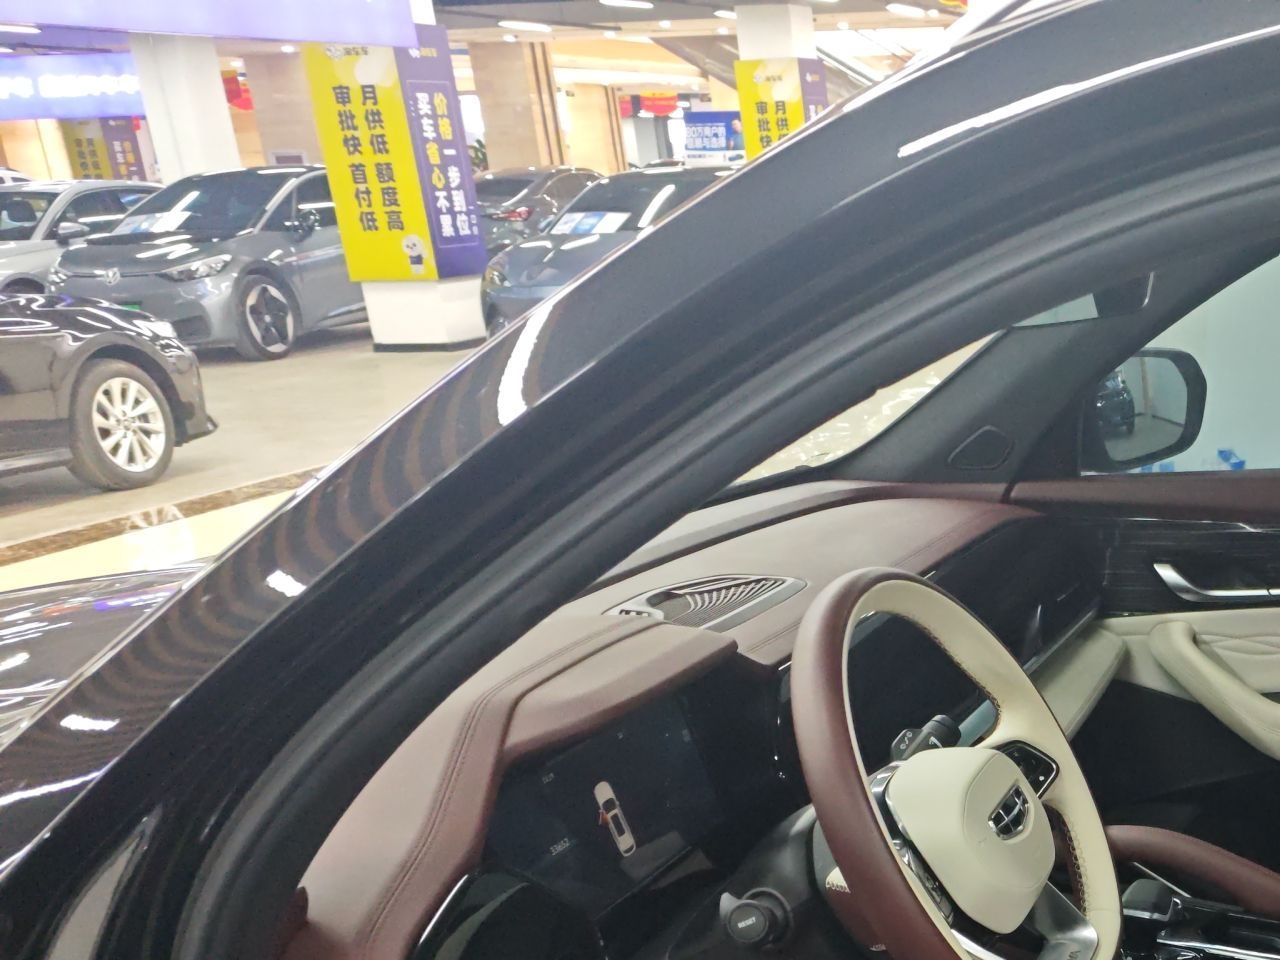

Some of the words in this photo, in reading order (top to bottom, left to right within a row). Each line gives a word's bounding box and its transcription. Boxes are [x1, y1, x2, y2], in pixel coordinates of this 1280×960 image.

[332, 84, 364, 156] 审批快
[348, 162, 379, 232] 首付低
[360, 84, 390, 156] 月供低
[415, 91, 456, 238] 买车省心不累
[432, 91, 472, 236] 价格一步到位
[374, 161, 405, 232] 额度高
